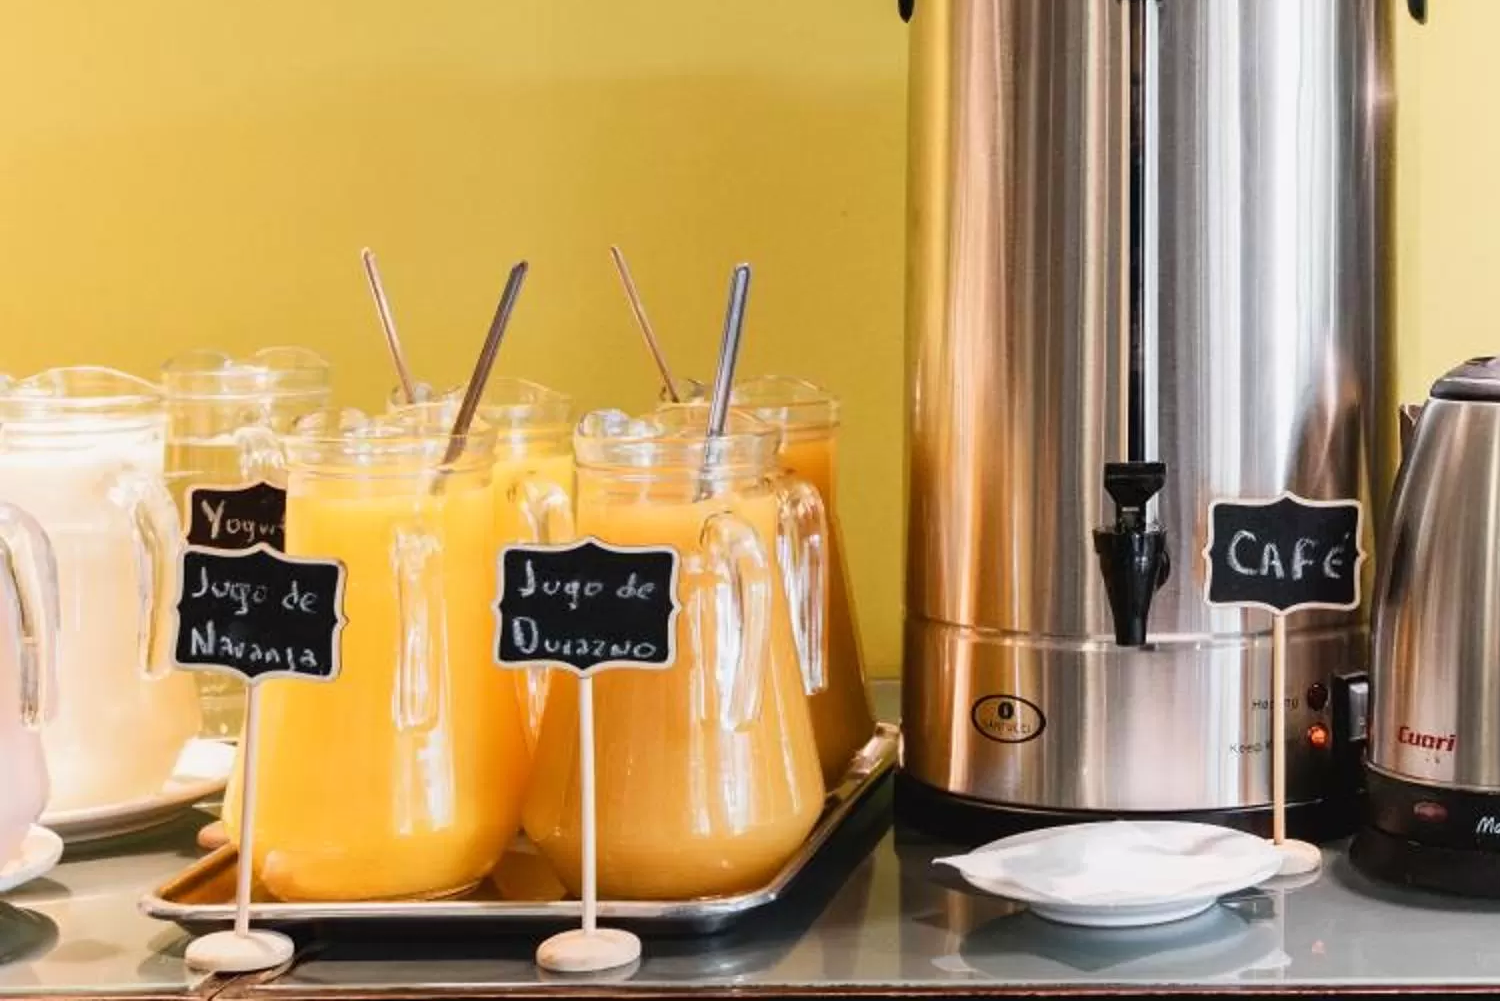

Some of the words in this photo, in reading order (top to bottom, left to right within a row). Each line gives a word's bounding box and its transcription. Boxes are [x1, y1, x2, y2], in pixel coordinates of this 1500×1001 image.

[191, 566, 267, 616] Jugo
[281, 580, 317, 614] de
[517, 559, 604, 611] Jugo
[615, 571, 657, 599] de
[1398, 726, 1456, 751] Cuori
